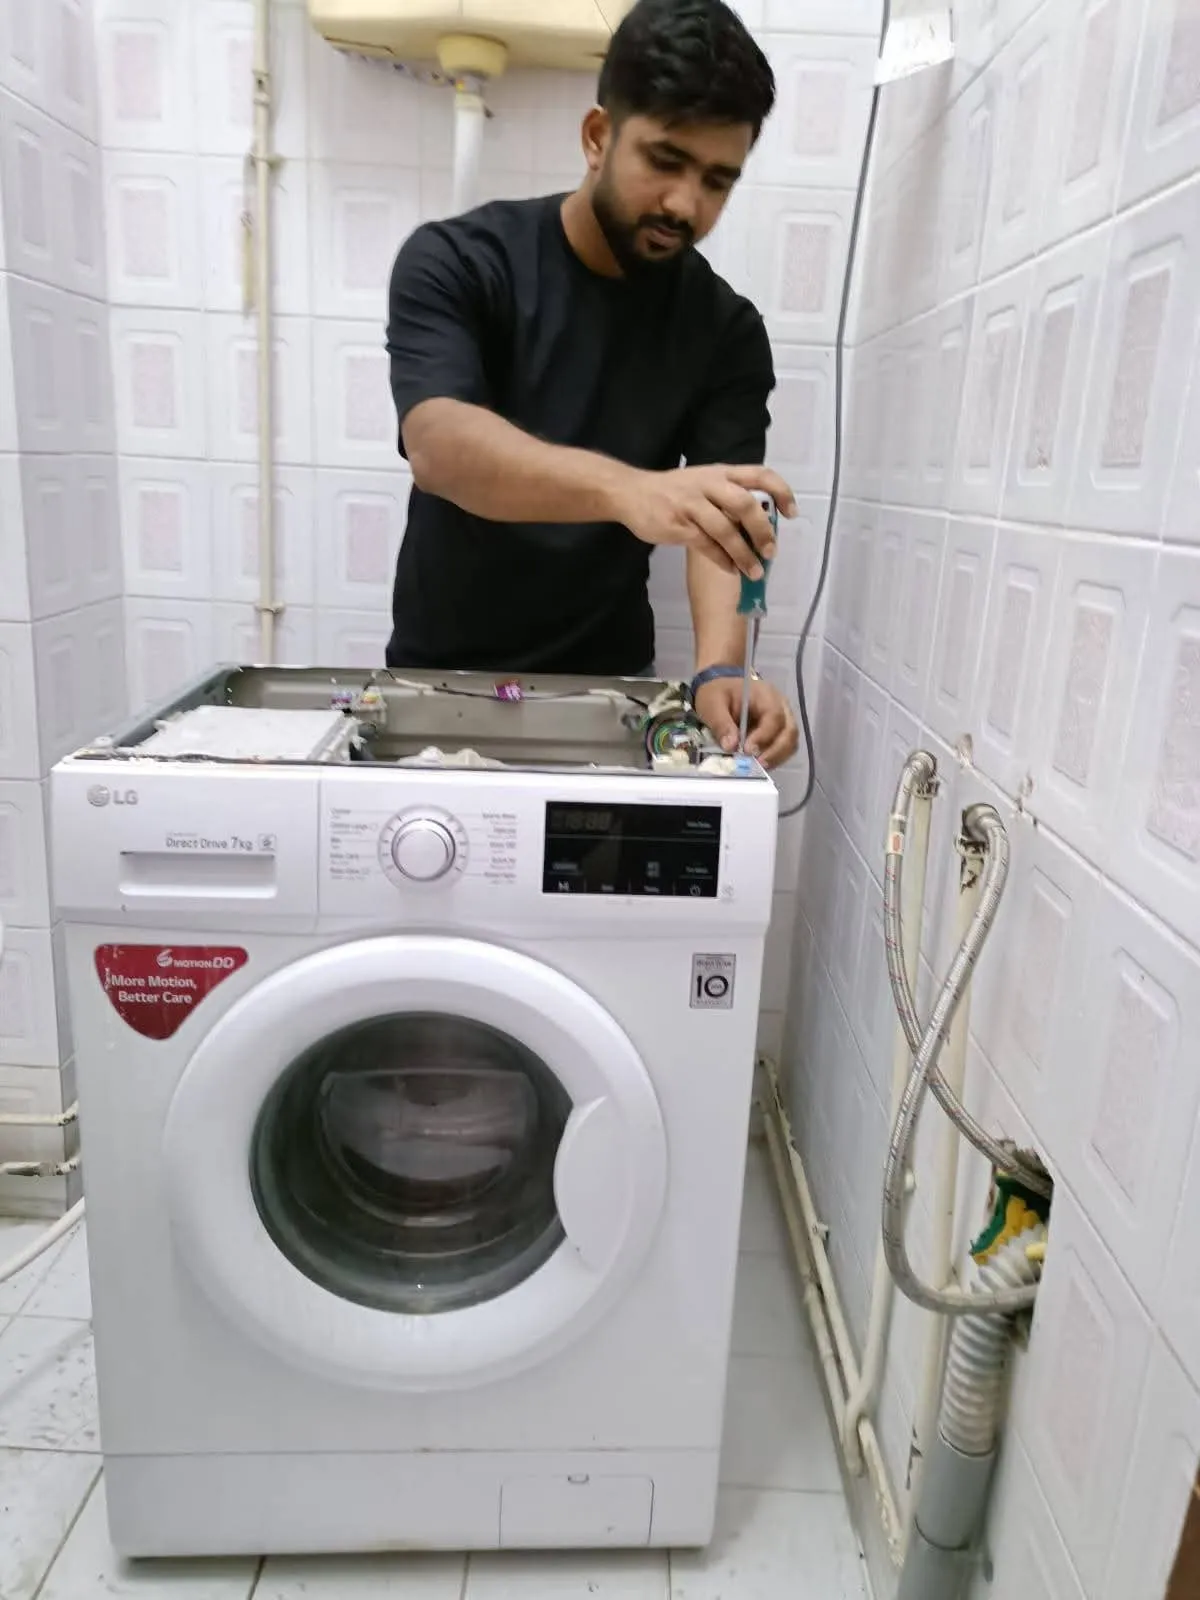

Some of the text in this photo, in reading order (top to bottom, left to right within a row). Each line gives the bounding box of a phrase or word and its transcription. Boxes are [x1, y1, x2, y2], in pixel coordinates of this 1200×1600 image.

[112, 789, 139, 806] LG
[165, 836, 198, 849] Direct
[200, 837, 228, 850] Drive
[111, 974, 197, 989] More Motion,
[696, 975, 729, 999] 10
[118, 990, 193, 1004] Better Care
